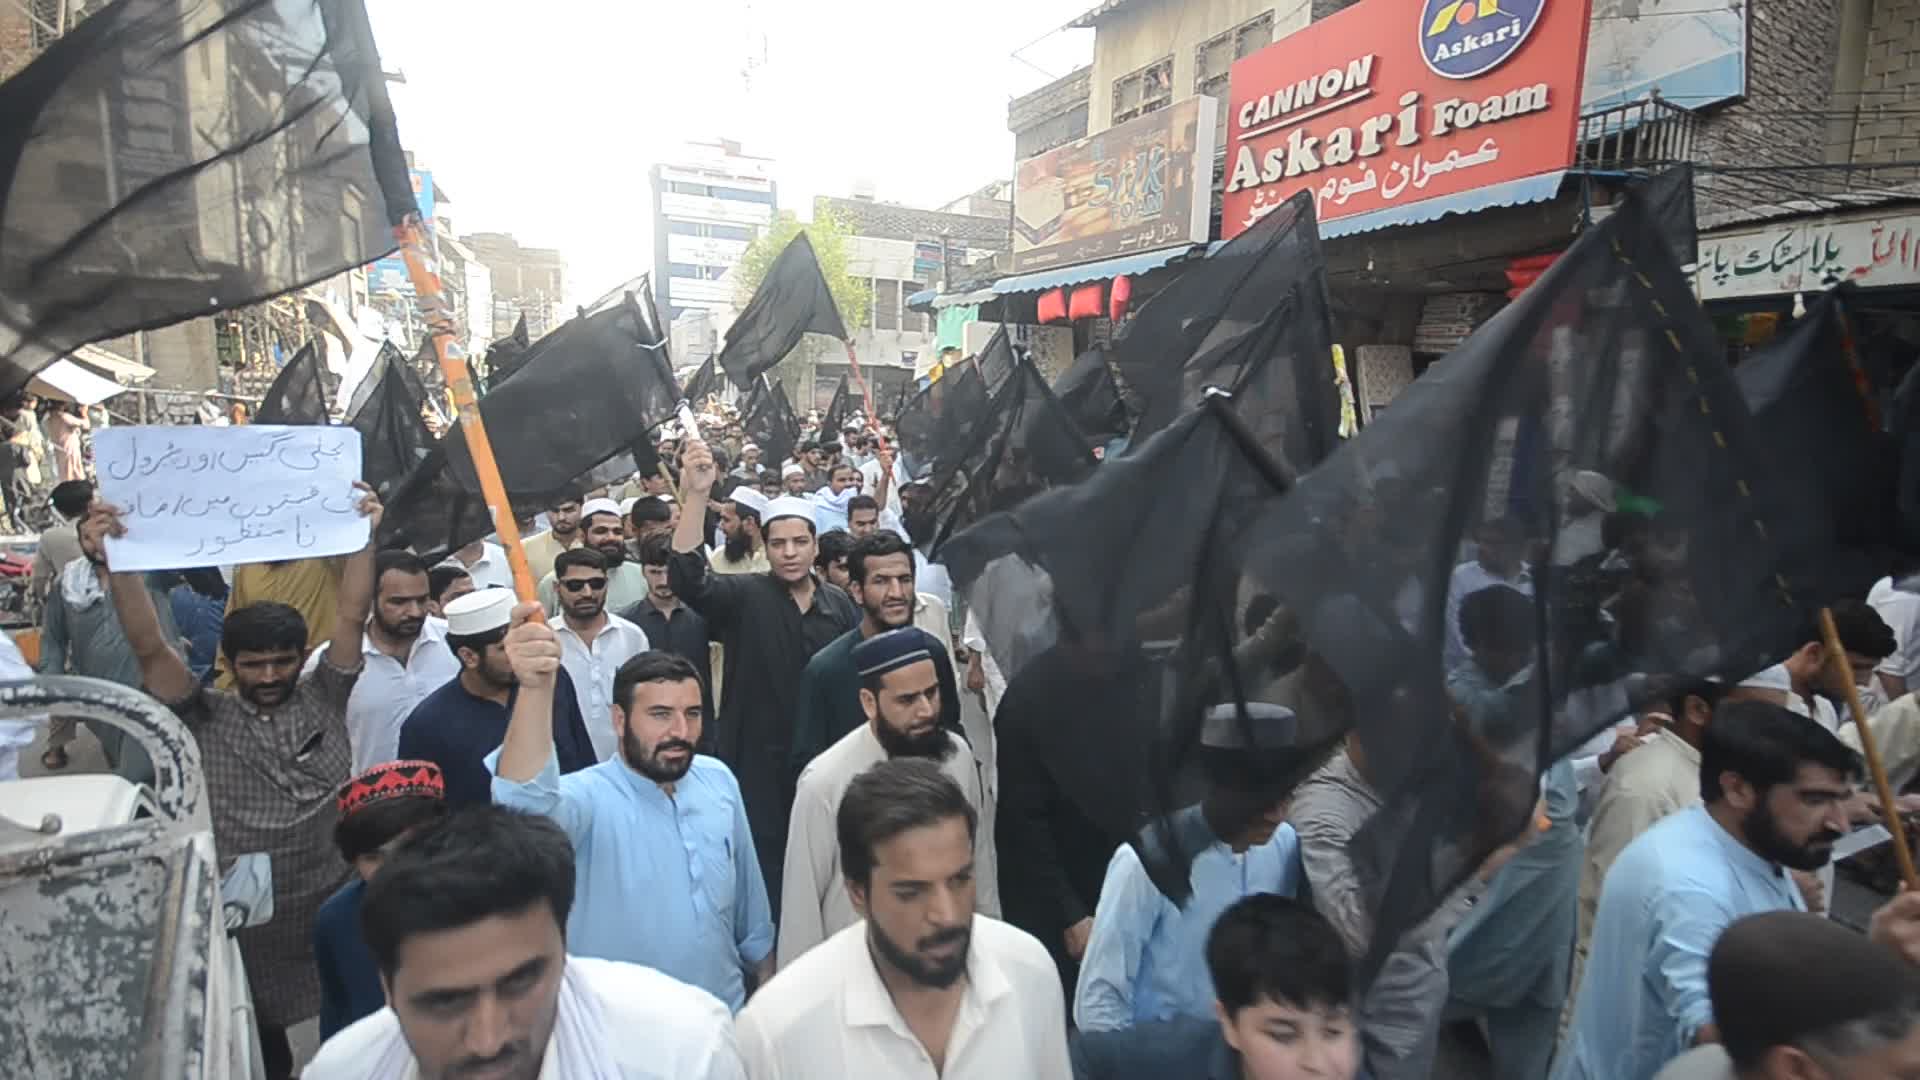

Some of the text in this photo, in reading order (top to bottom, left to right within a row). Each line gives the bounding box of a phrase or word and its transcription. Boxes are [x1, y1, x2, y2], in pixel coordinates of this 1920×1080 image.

[1432, 19, 1521, 63] Askari
[1239, 54, 1375, 130] CANNON
[1226, 82, 1550, 193] Askari Foam
[1316, 161, 1377, 220] فوم
[1381, 138, 1499, 199] عمران
[1734, 229, 1845, 285] پلاسٹک
[175, 450, 217, 473] اور
[218, 430, 297, 473] گیس
[279, 434, 345, 470] بجلی
[184, 516, 286, 557] منظور
